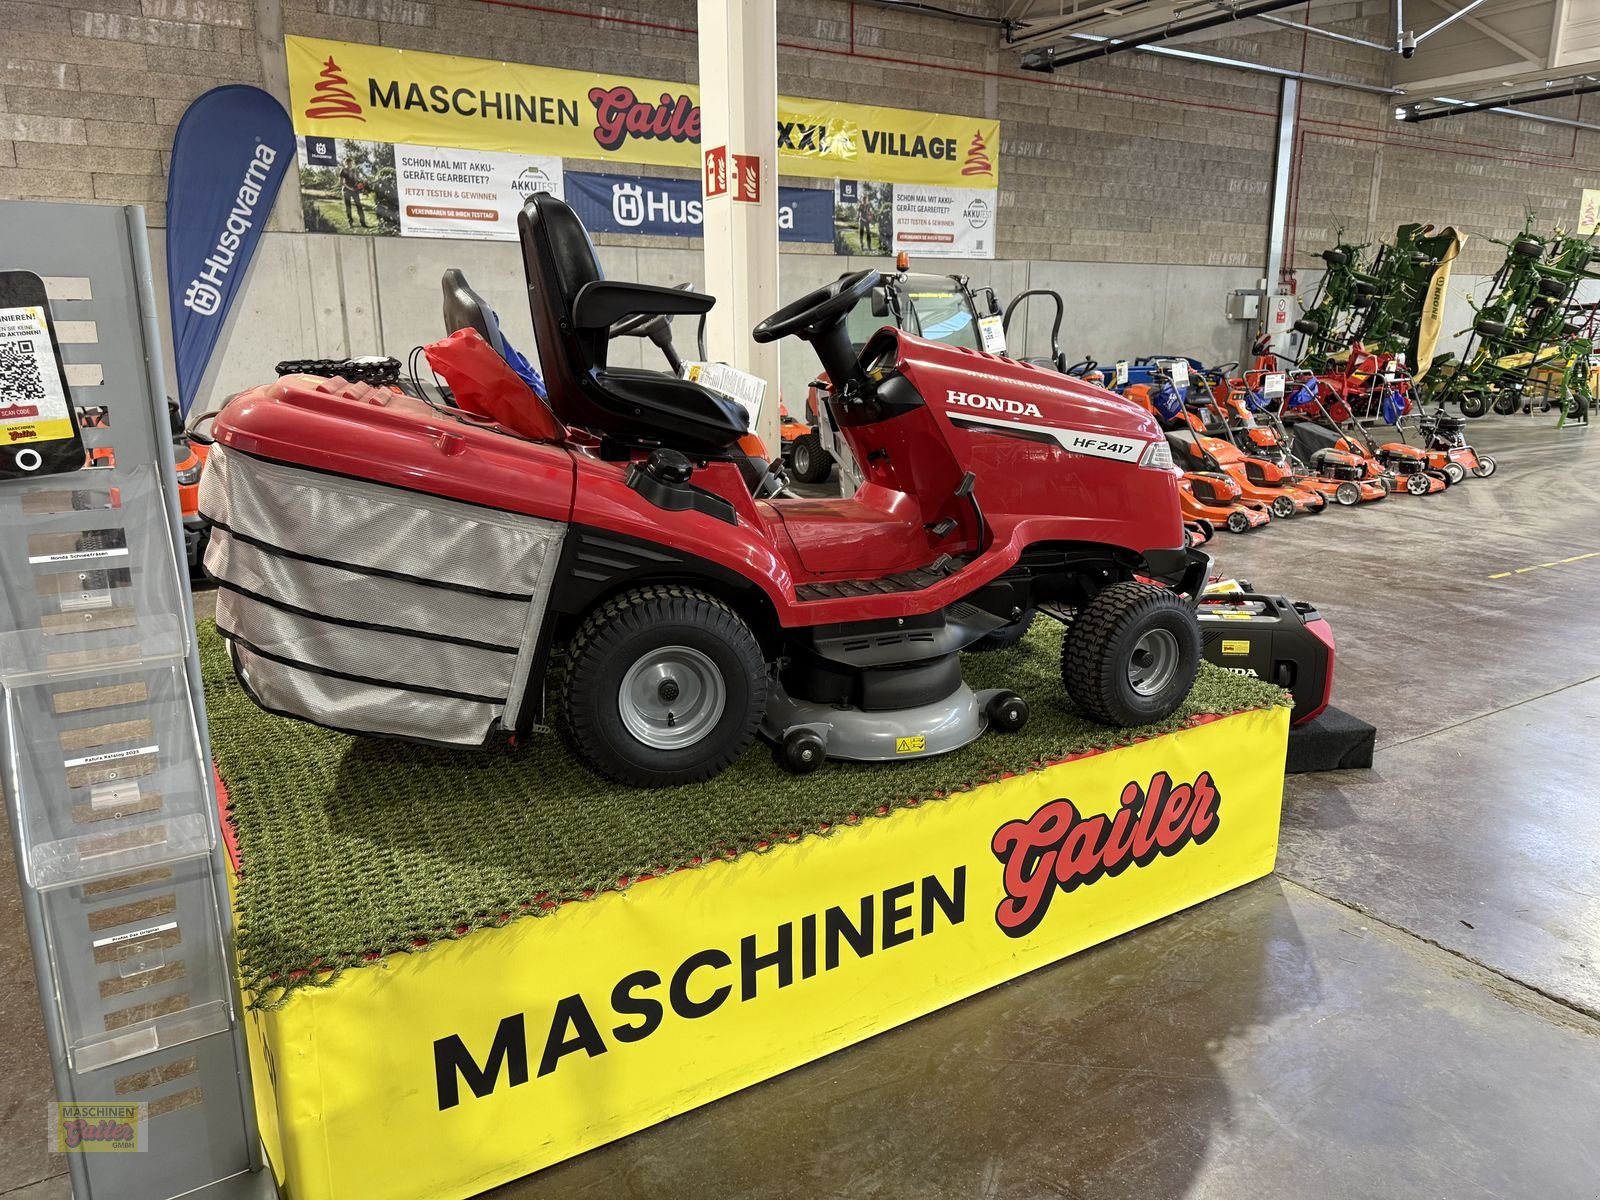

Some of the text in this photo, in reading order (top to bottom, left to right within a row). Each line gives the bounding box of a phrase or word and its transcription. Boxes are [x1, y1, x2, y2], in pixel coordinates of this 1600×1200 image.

[368, 78, 579, 126] MASCHINEN
[588, 86, 701, 151] Gaile
[862, 129, 957, 161] VILLAGE
[402, 157, 495, 172] SCHON MAL MIT AKKU-
[403, 169, 490, 184] GERÄTE GEARBEITET?
[511, 180, 558, 192] AKKUTEST
[404, 188, 424, 196] JETZT
[427, 189, 452, 198] TESTEN
[461, 192, 497, 200] GEWINNEN
[896, 194, 915, 202] SCHON
[916, 195, 927, 203] MAL
[200, 143, 277, 287] Husqvarna
[896, 204, 950, 214] GERÄTE GEARBEITET?
[1431, 287, 1441, 321] KRONE
[0, 313, 36, 323] NIEREN!
[946, 390, 1043, 418] HONDA
[1073, 437, 1133, 455] HF 2417
[433, 771, 1222, 1110] MASCHINEN Gailer
